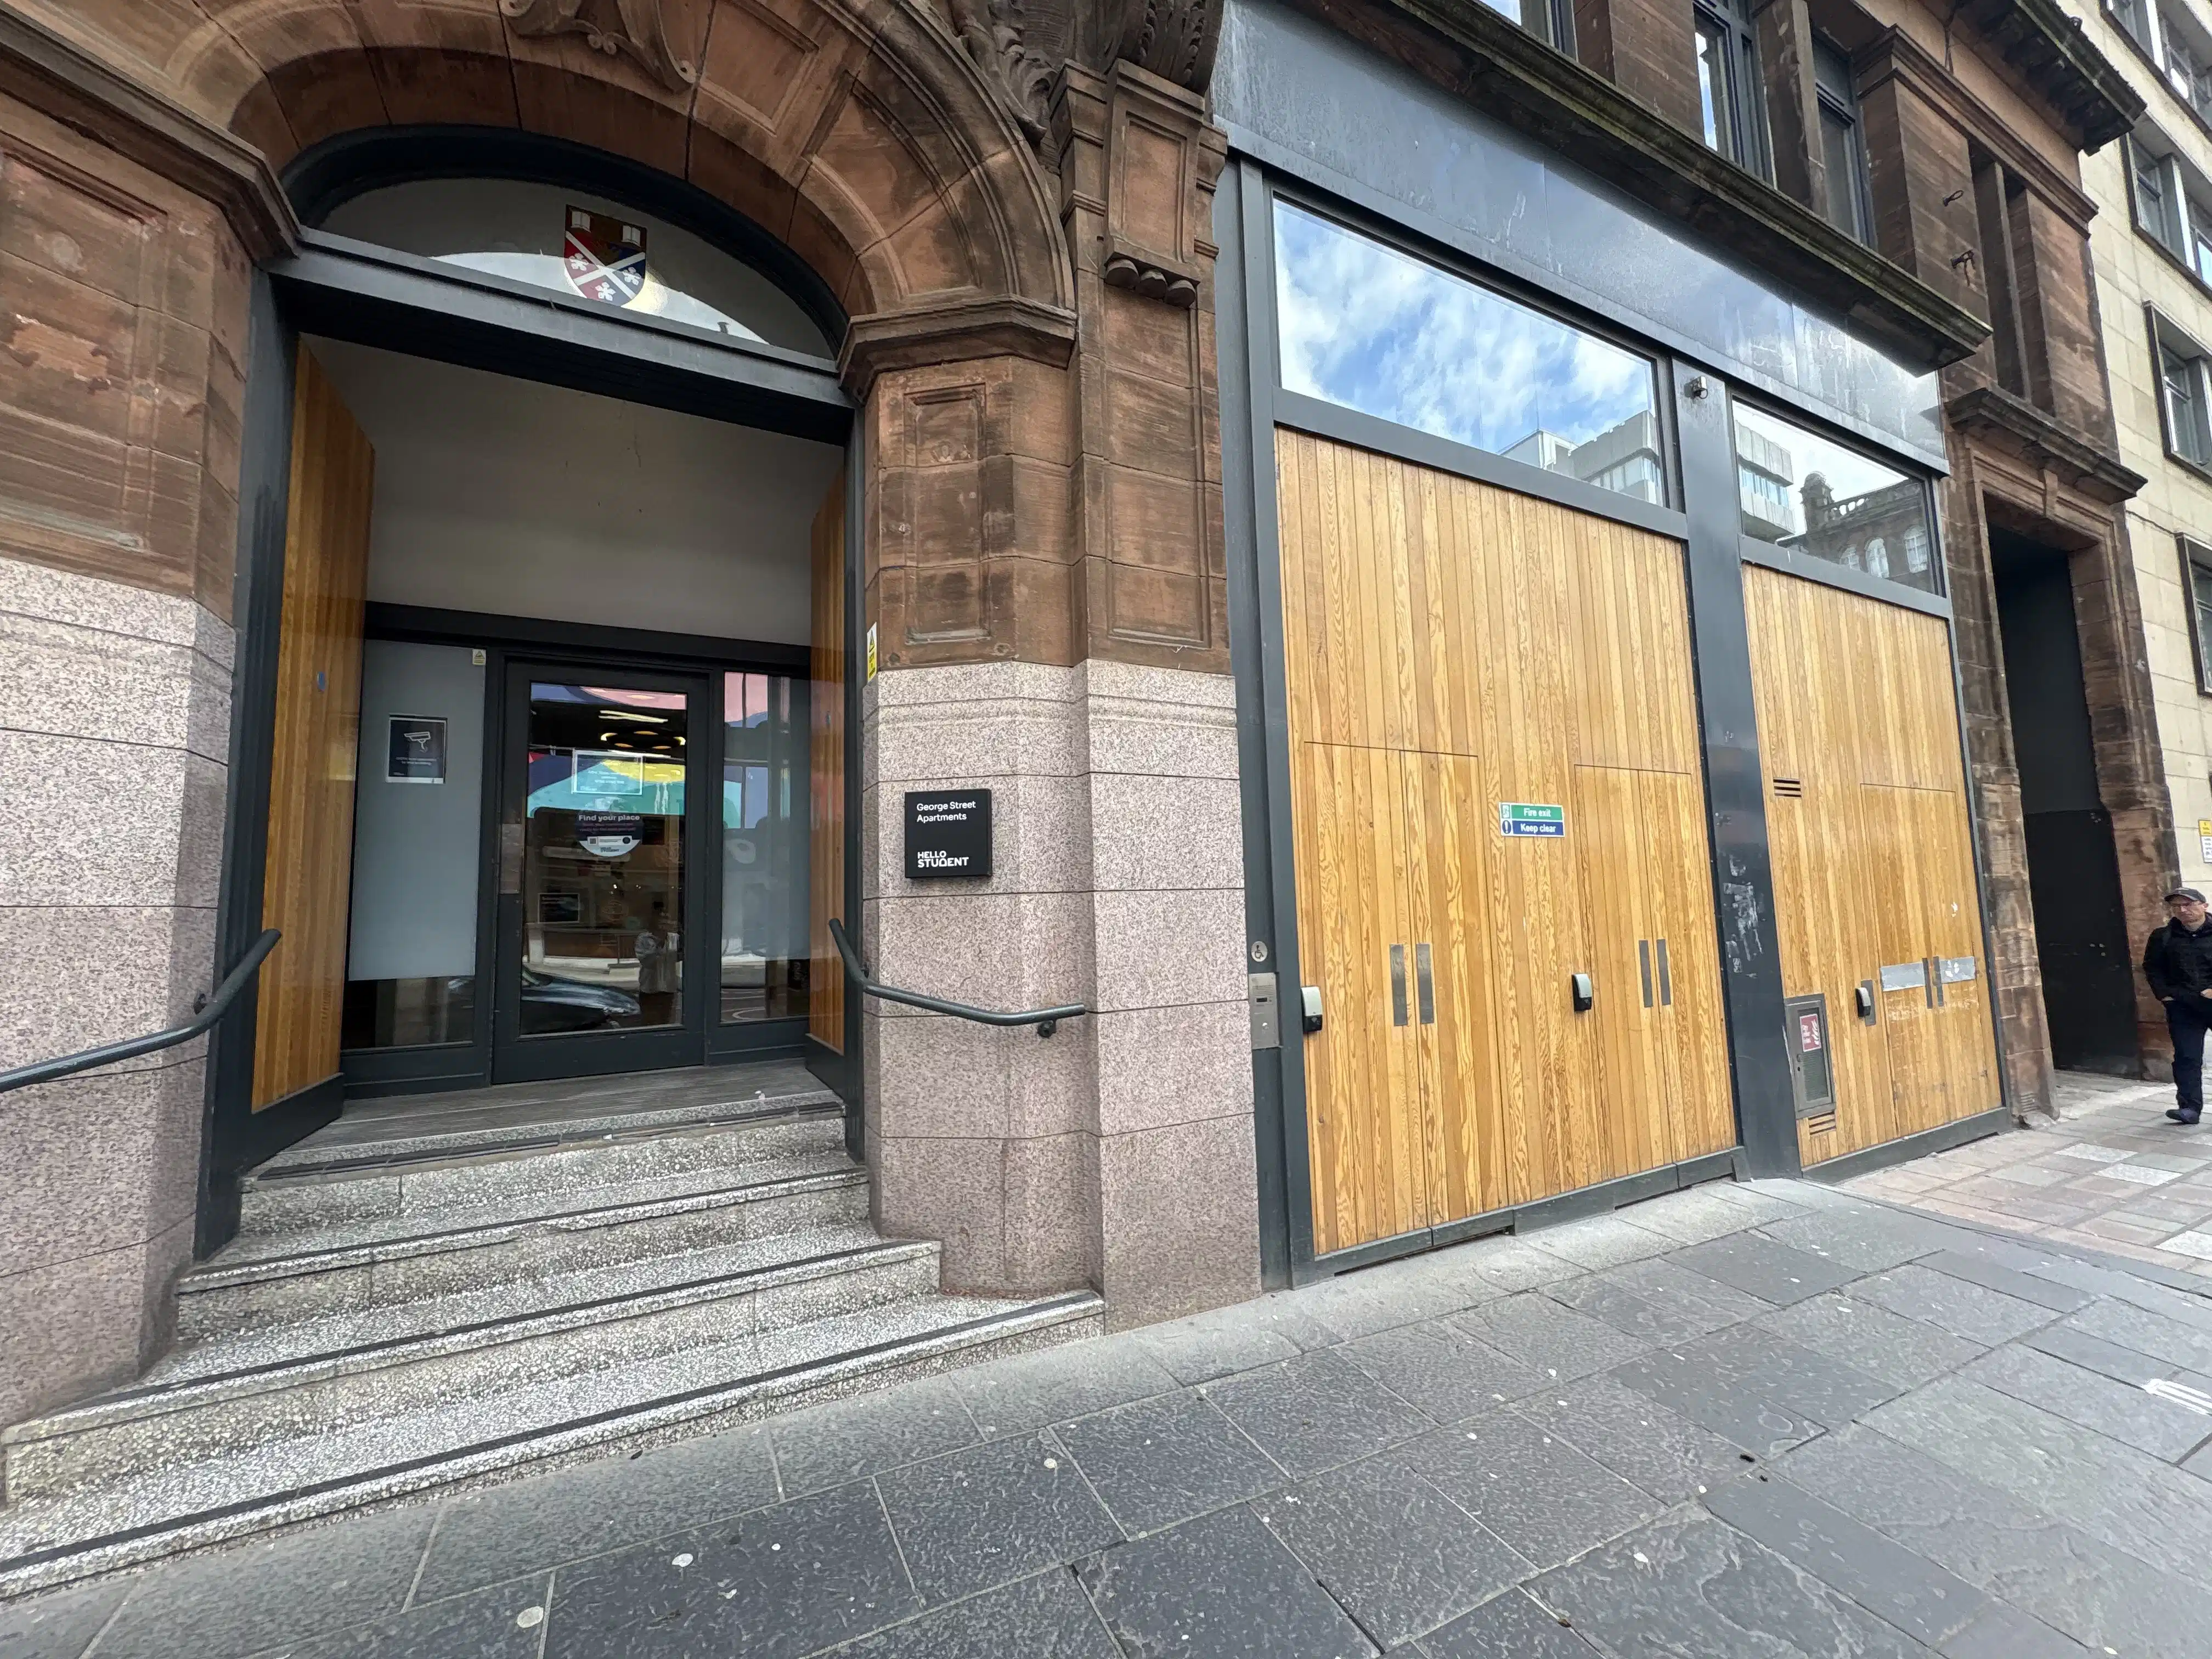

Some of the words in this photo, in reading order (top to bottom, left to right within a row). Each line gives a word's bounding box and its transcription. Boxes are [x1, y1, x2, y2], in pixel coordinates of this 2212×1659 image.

[917, 803, 949, 812] George
[950, 801, 977, 810] Street
[917, 812, 967, 823] Apartments
[1523, 808, 1537, 817] Fire
[1538, 809, 1551, 817] exit
[1520, 823, 1538, 834] Keep
[1539, 824, 1556, 833] clear
[917, 850, 947, 859] HELLO
[917, 857, 969, 868] STUDENT
